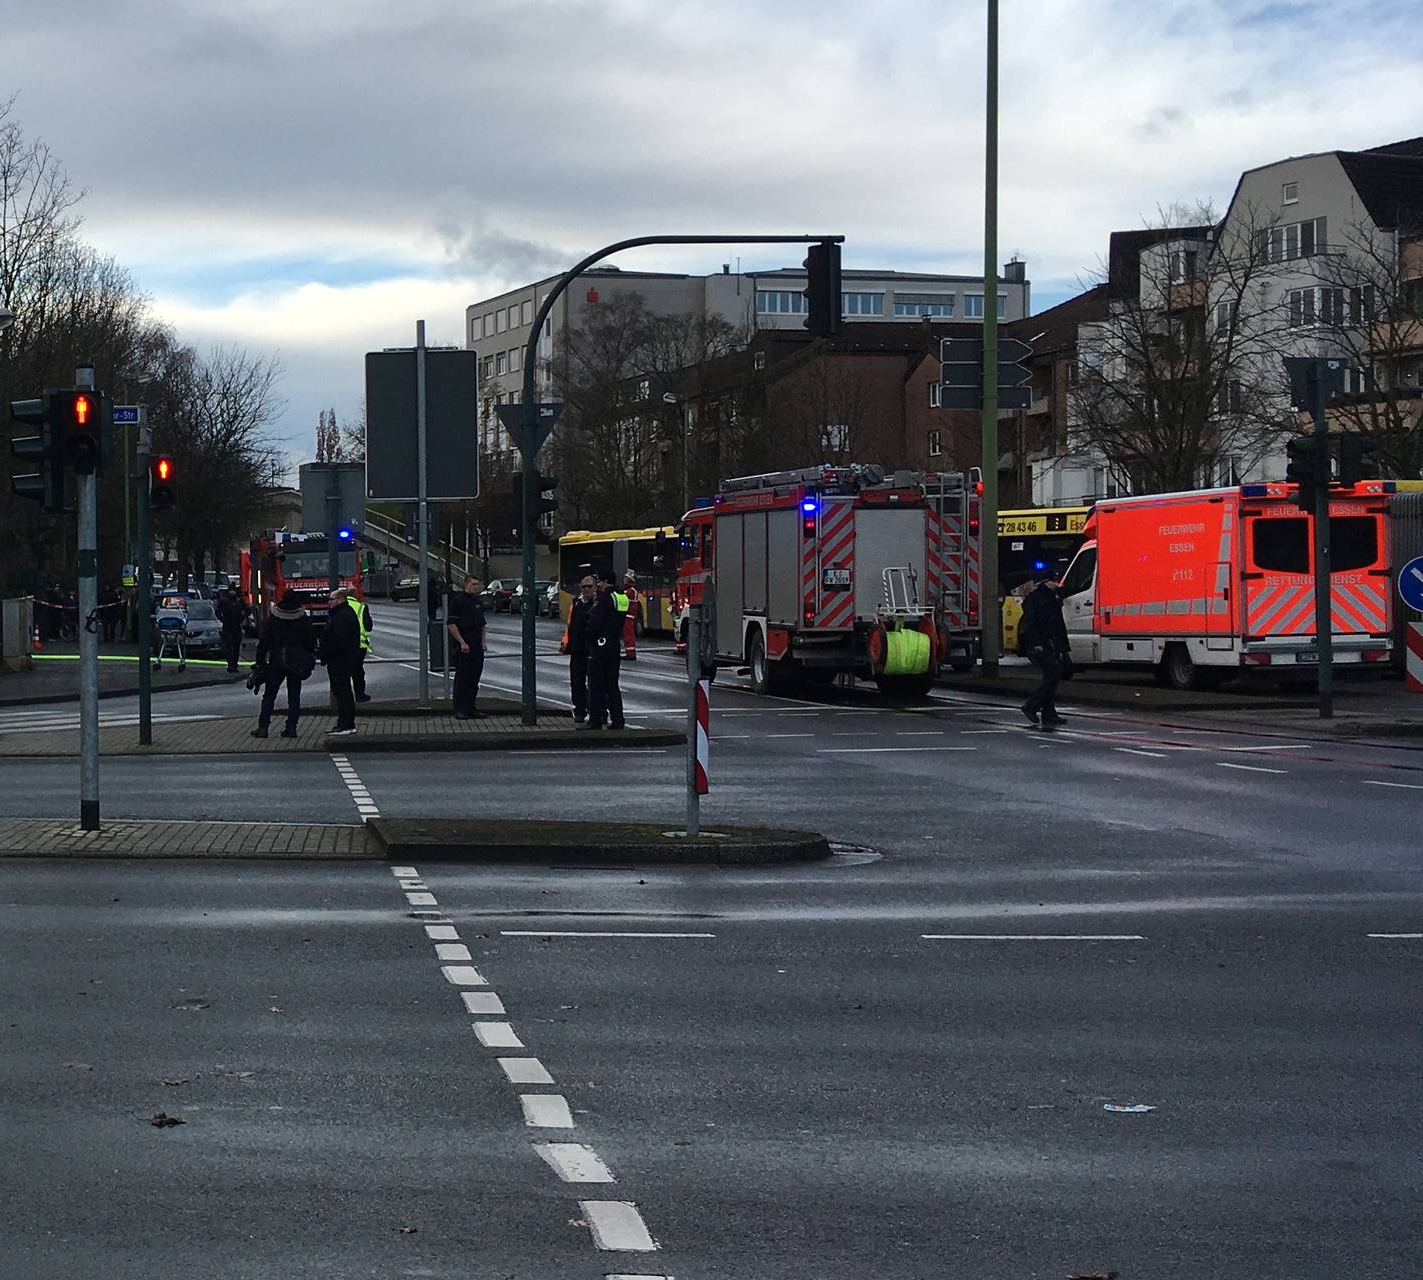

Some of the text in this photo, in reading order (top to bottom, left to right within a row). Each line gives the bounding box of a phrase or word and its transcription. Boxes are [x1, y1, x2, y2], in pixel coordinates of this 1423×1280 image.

[1267, 506, 1308, 515] FEUER
[1006, 521, 1037, 532] 28 43 46
[1070, 519, 1084, 530] Ess
[1159, 524, 1205, 535] FEUERWEHR
[1170, 543, 1194, 552] ESSEN
[1265, 575, 1362, 587] RETTUNGIENST
